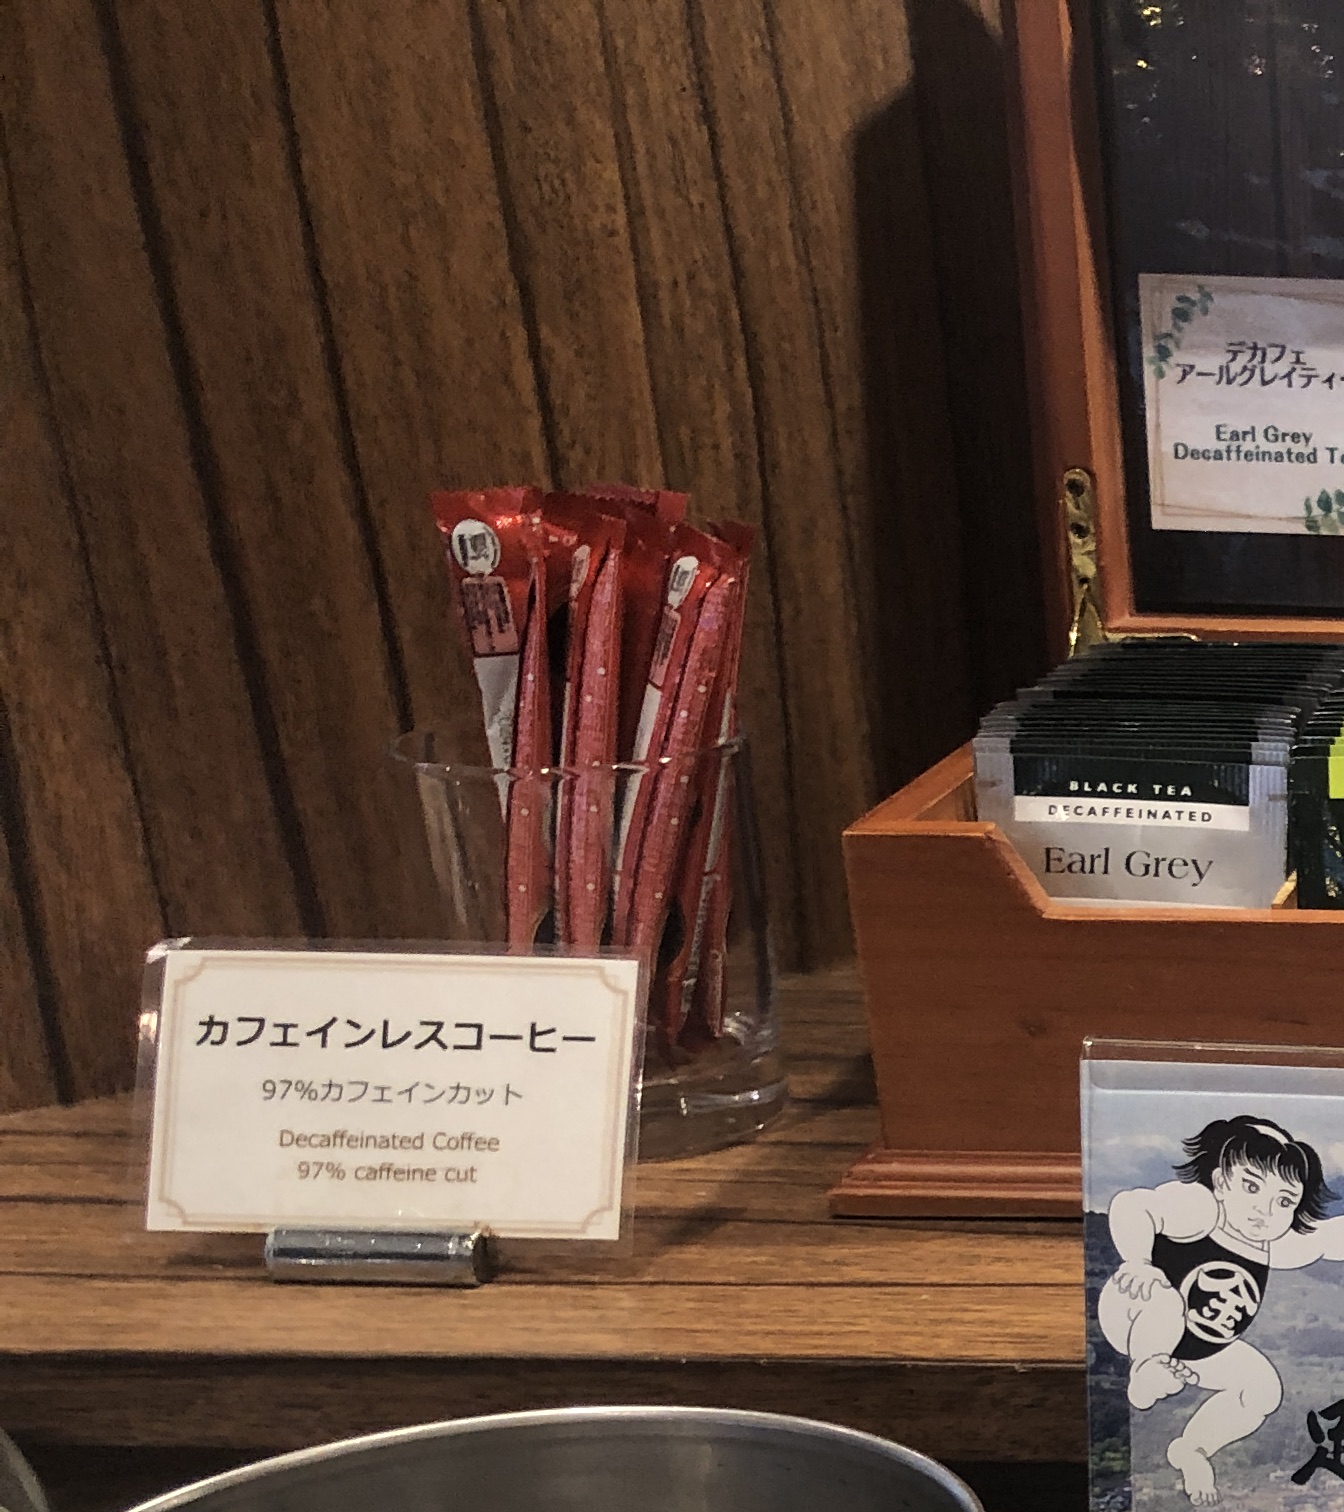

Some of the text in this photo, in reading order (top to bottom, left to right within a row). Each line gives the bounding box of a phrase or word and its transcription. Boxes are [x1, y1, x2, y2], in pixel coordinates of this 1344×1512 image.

[1225, 341, 1307, 366] デカフェ
[1215, 424, 1313, 447] Earl Grey
[1173, 442, 1318, 466] Decaffeinated
[1069, 780, 1192, 797] BLACK TEA
[1045, 846, 1213, 887] Earl Grey
[195, 1014, 597, 1054] カフェインレスコーヒー
[261, 1079, 524, 1106] 97%カフェインカット
[280, 1129, 500, 1152] Decaffeinated Coffee
[297, 1162, 478, 1184] 97% caffeine cut
